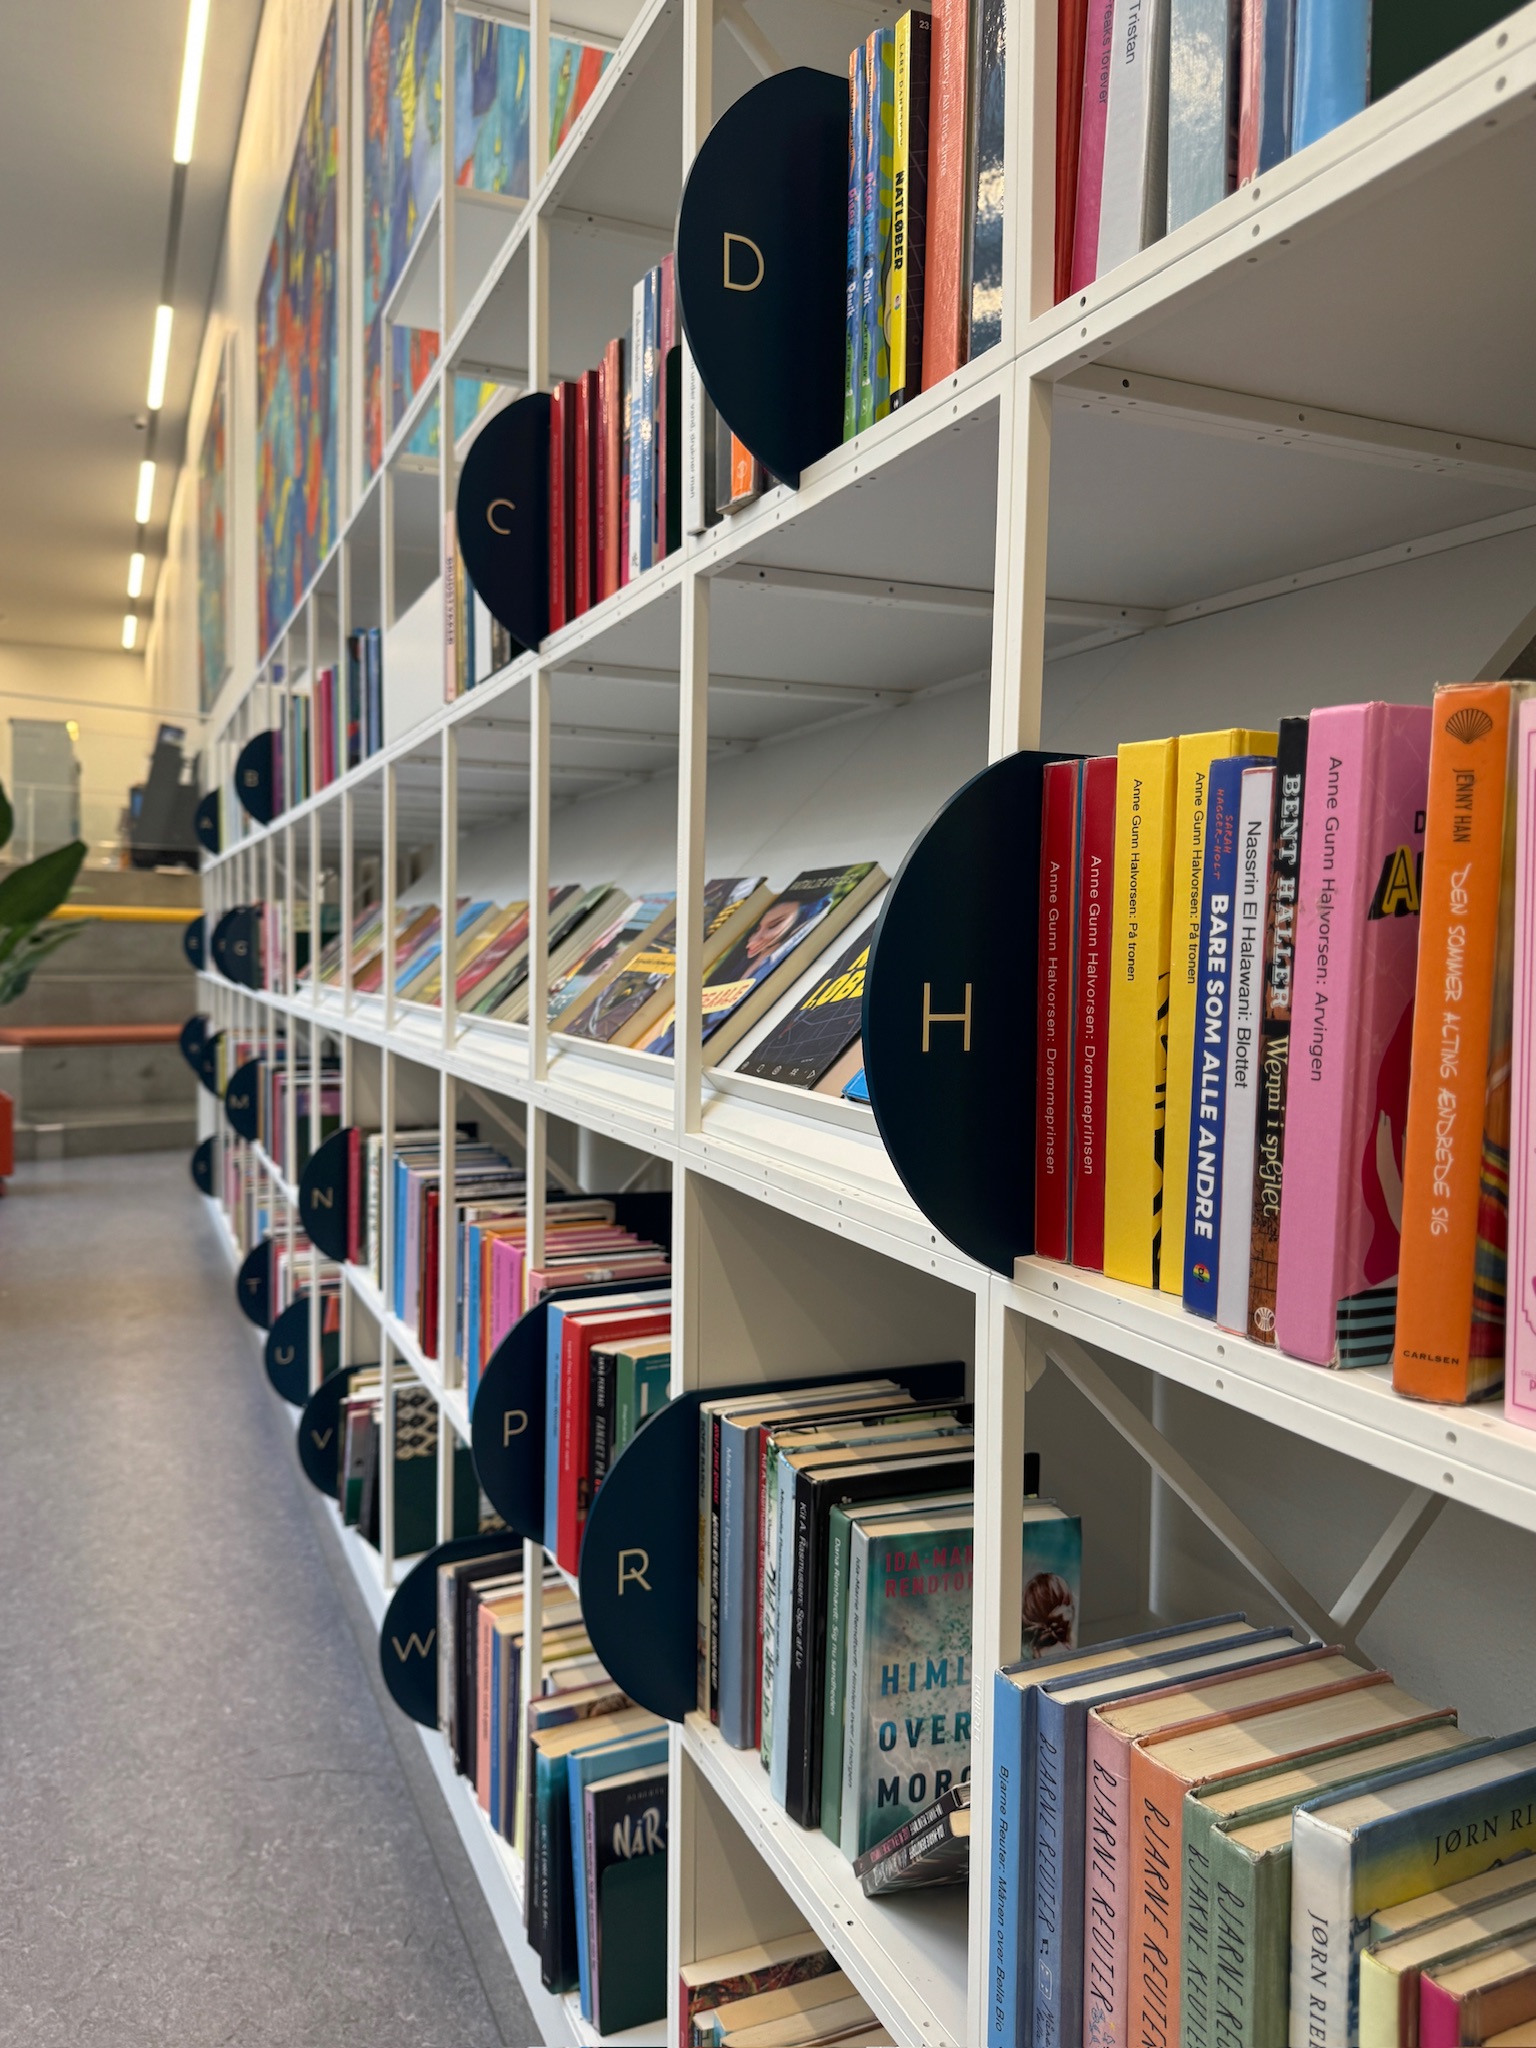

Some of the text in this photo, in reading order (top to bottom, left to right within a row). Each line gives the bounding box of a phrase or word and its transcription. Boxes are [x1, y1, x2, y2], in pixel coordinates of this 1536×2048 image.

[1099, 0, 1114, 104] reaks forever
[1125, 0, 1141, 65] Tristan
[940, 114, 949, 142] this
[939, 148, 948, 176] time
[893, 170, 905, 271] NATLØBER
[723, 231, 765, 292] D
[863, 269, 874, 305] Panik
[846, 282, 856, 319] Panik
[487, 498, 516, 535] C
[1452, 768, 1475, 843] JENNY HAN
[1213, 788, 1225, 881] HAGGER-HOLT
[1223, 815, 1233, 855] SARAH
[1126, 778, 1143, 982] Anne Gunn Halvorsen: På tronen
[1187, 772, 1206, 985] Anne Gunn Halvorsen: På tronen
[1270, 774, 1301, 1010] BENT HALLER
[1450, 862, 1473, 917] DEN
[1309, 756, 1343, 1082] Anne Gunn Halvorsen: Arvingen
[1234, 821, 1262, 1090] Nassrin El Halawani: Blottet
[1444, 924, 1466, 1003] SOMMER
[922, 982, 972, 1052] H
[1044, 860, 1061, 1175] Anne Gunn Halvorsen: Drømmeprinsen
[1081, 855, 1102, 1175] Anne Gunn Halvorsen: Drømmeprinsen
[1194, 894, 1229, 1241] BARE SOM ALLE ANDRE
[230, 1095, 249, 1109] M
[1259, 1034, 1289, 1218] Wenni i spejlet
[1433, 1086, 1457, 1199] ÆNDREDE
[311, 1186, 333, 1210] N
[1430, 1206, 1449, 1236] SIG
[246, 1277, 262, 1295] T
[275, 1345, 295, 1365] U
[1403, 1350, 1460, 1366] CARLSEN
[311, 1427, 333, 1449] V
[503, 1409, 529, 1448] P
[799, 1501, 807, 1520] Kit
[617, 1547, 652, 1596] R
[797, 1535, 808, 1607] Rasmussen:
[885, 1544, 973, 1573] IDA-MAR
[885, 1571, 973, 1599] RENDTO
[796, 1608, 805, 1636] Spor
[832, 1568, 841, 1622] Reinhardt:
[391, 1627, 436, 1662] W
[795, 1636, 803, 1648] af
[795, 1650, 803, 1669] Liv
[831, 1624, 839, 1642] Sig
[831, 1644, 837, 1658] nu
[829, 1660, 838, 1716] sandheden
[881, 1655, 971, 1697] HIML
[878, 1711, 971, 1752] OVER
[1038, 1731, 1058, 1933] BJARNE REUTER
[1432, 1803, 1535, 1867] JØRN RI
[1090, 1759, 1118, 2014] BJARNE REUTER
[1144, 1797, 1171, 1939] BJARNE
[994, 1765, 1010, 2032] Bjarne Reuter: Månen over Bella Bio
[1216, 1881, 1246, 2007] BJARNE
[1307, 1909, 1329, 1988] JØRN
[1186, 1958, 1208, 2048] REUTE
